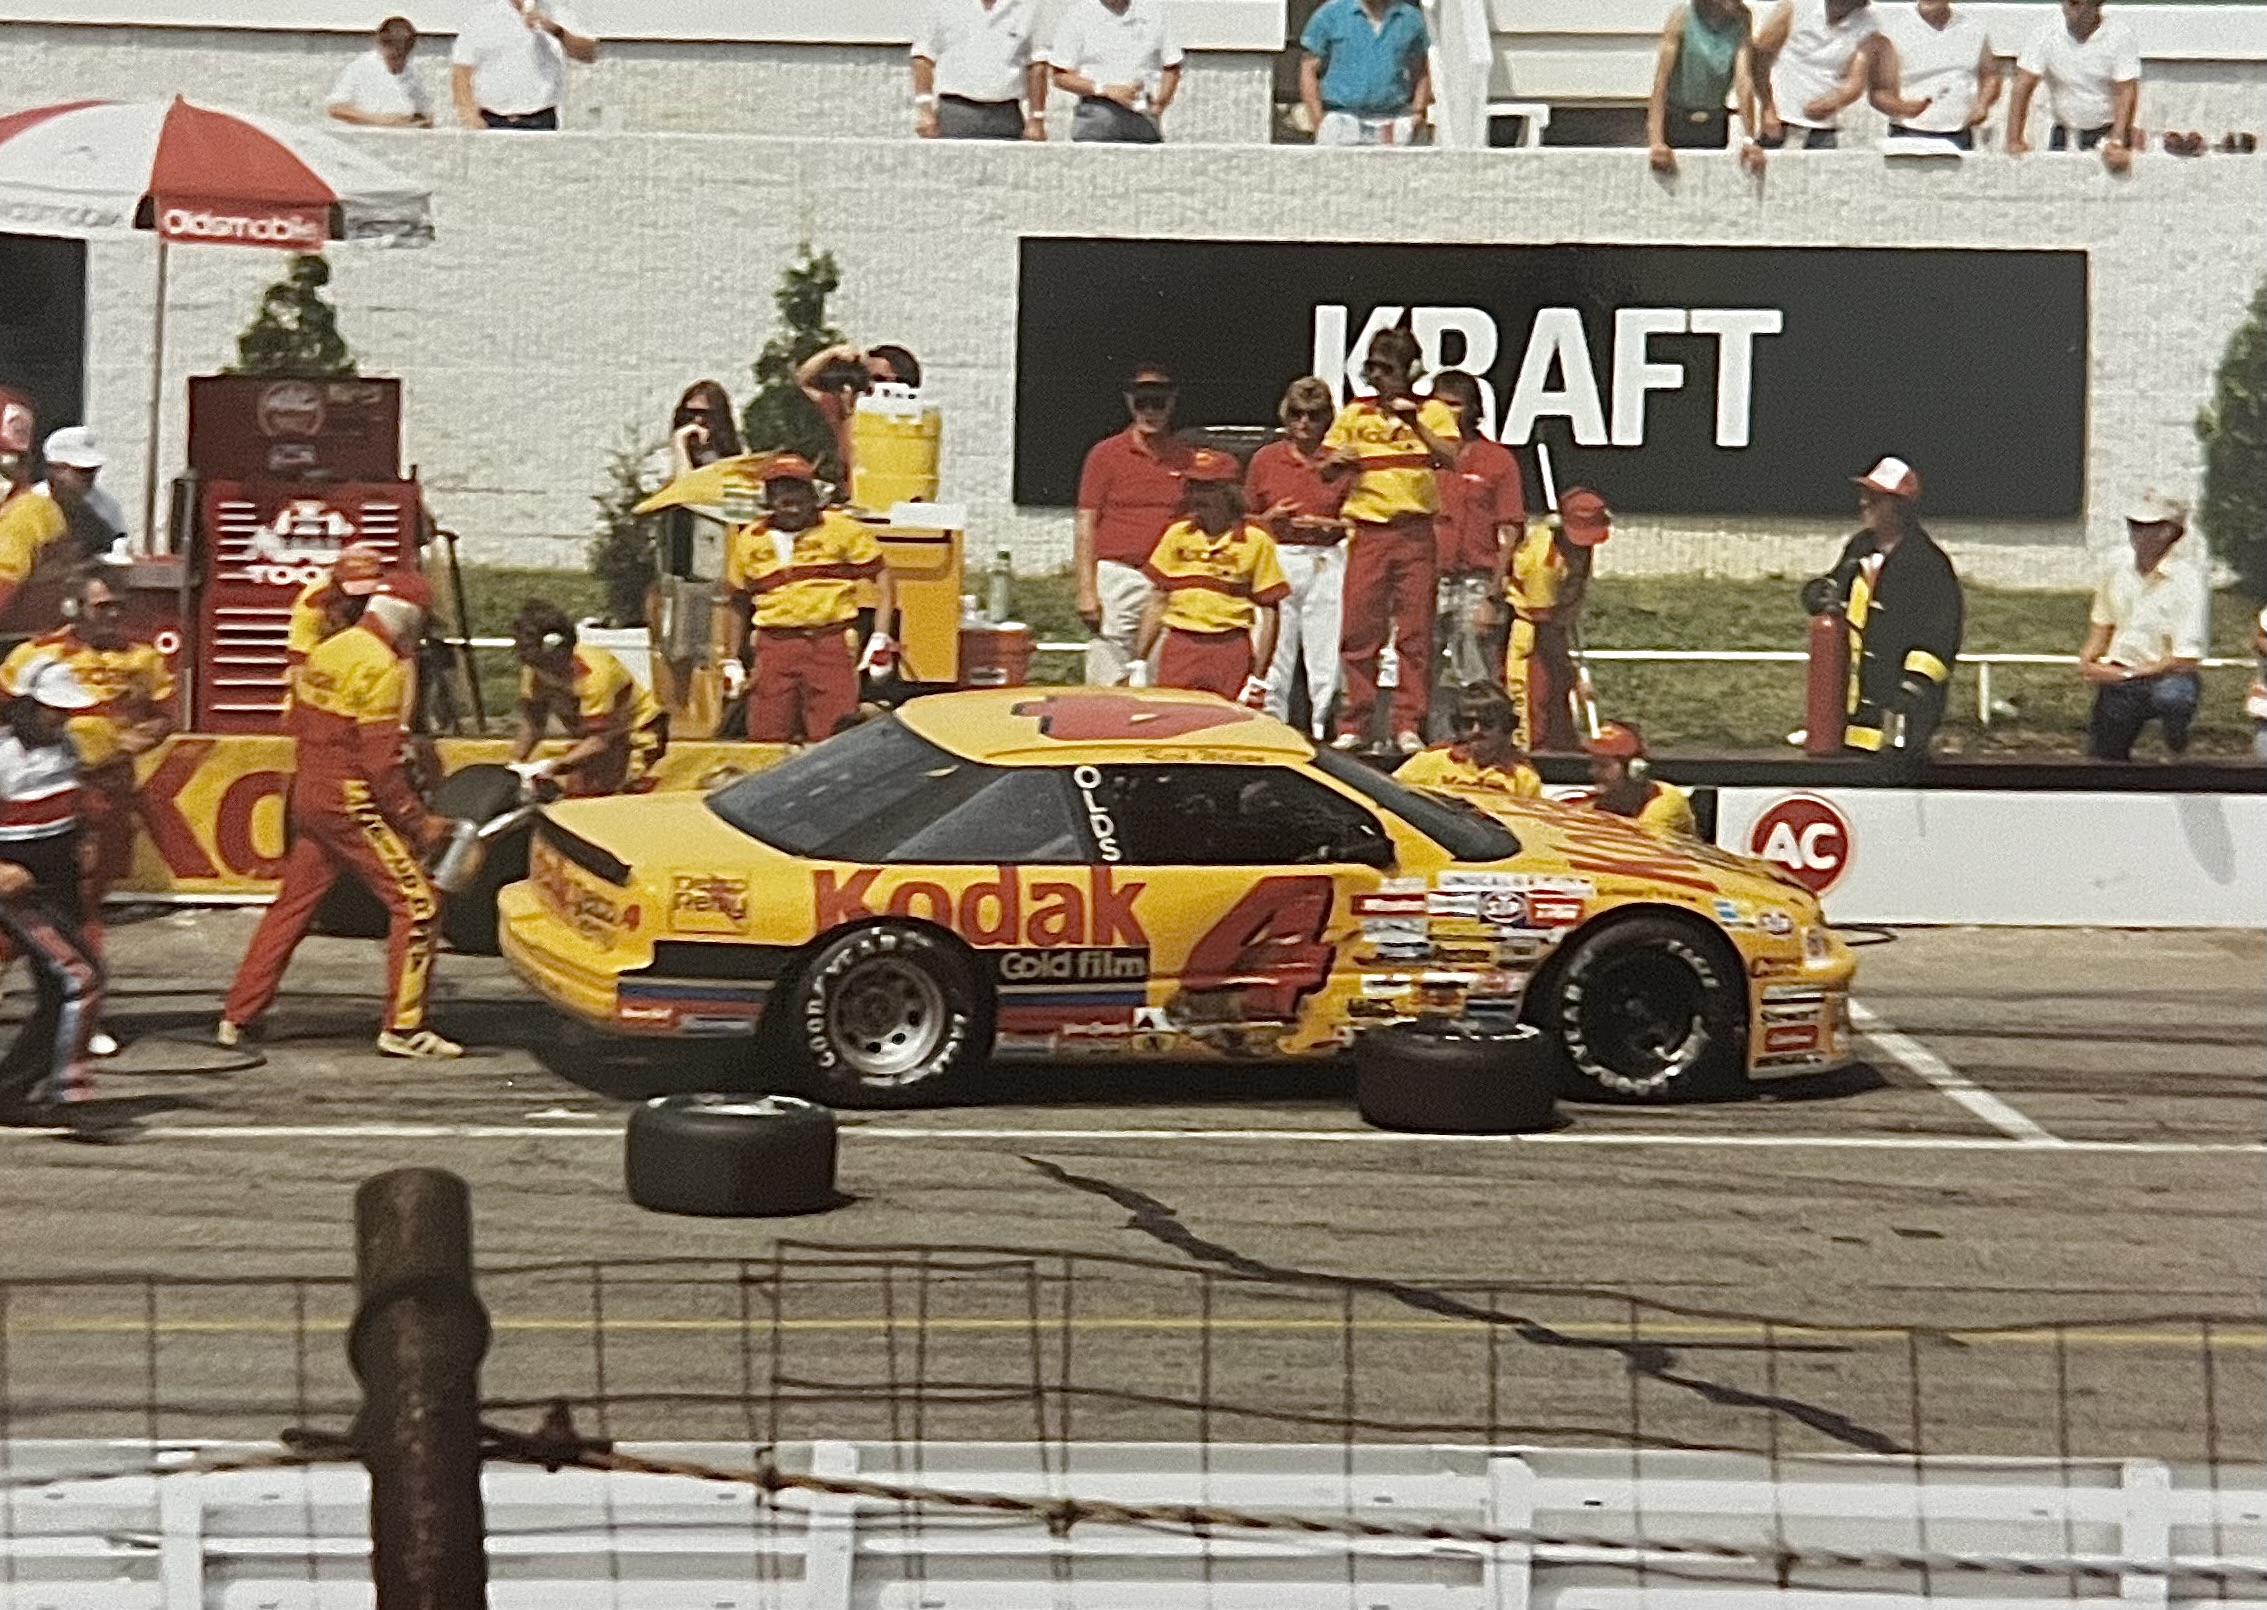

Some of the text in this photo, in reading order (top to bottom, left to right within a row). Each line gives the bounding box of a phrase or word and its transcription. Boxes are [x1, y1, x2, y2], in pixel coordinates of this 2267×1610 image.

[1314, 304, 1784, 447] KRAFT
[1073, 766, 1122, 861] OLDS
[1762, 821, 1837, 870] AC
[811, 864, 1149, 948] Kodak
[1178, 874, 1336, 1021] 4
[1001, 951, 1146, 980] Gold film
